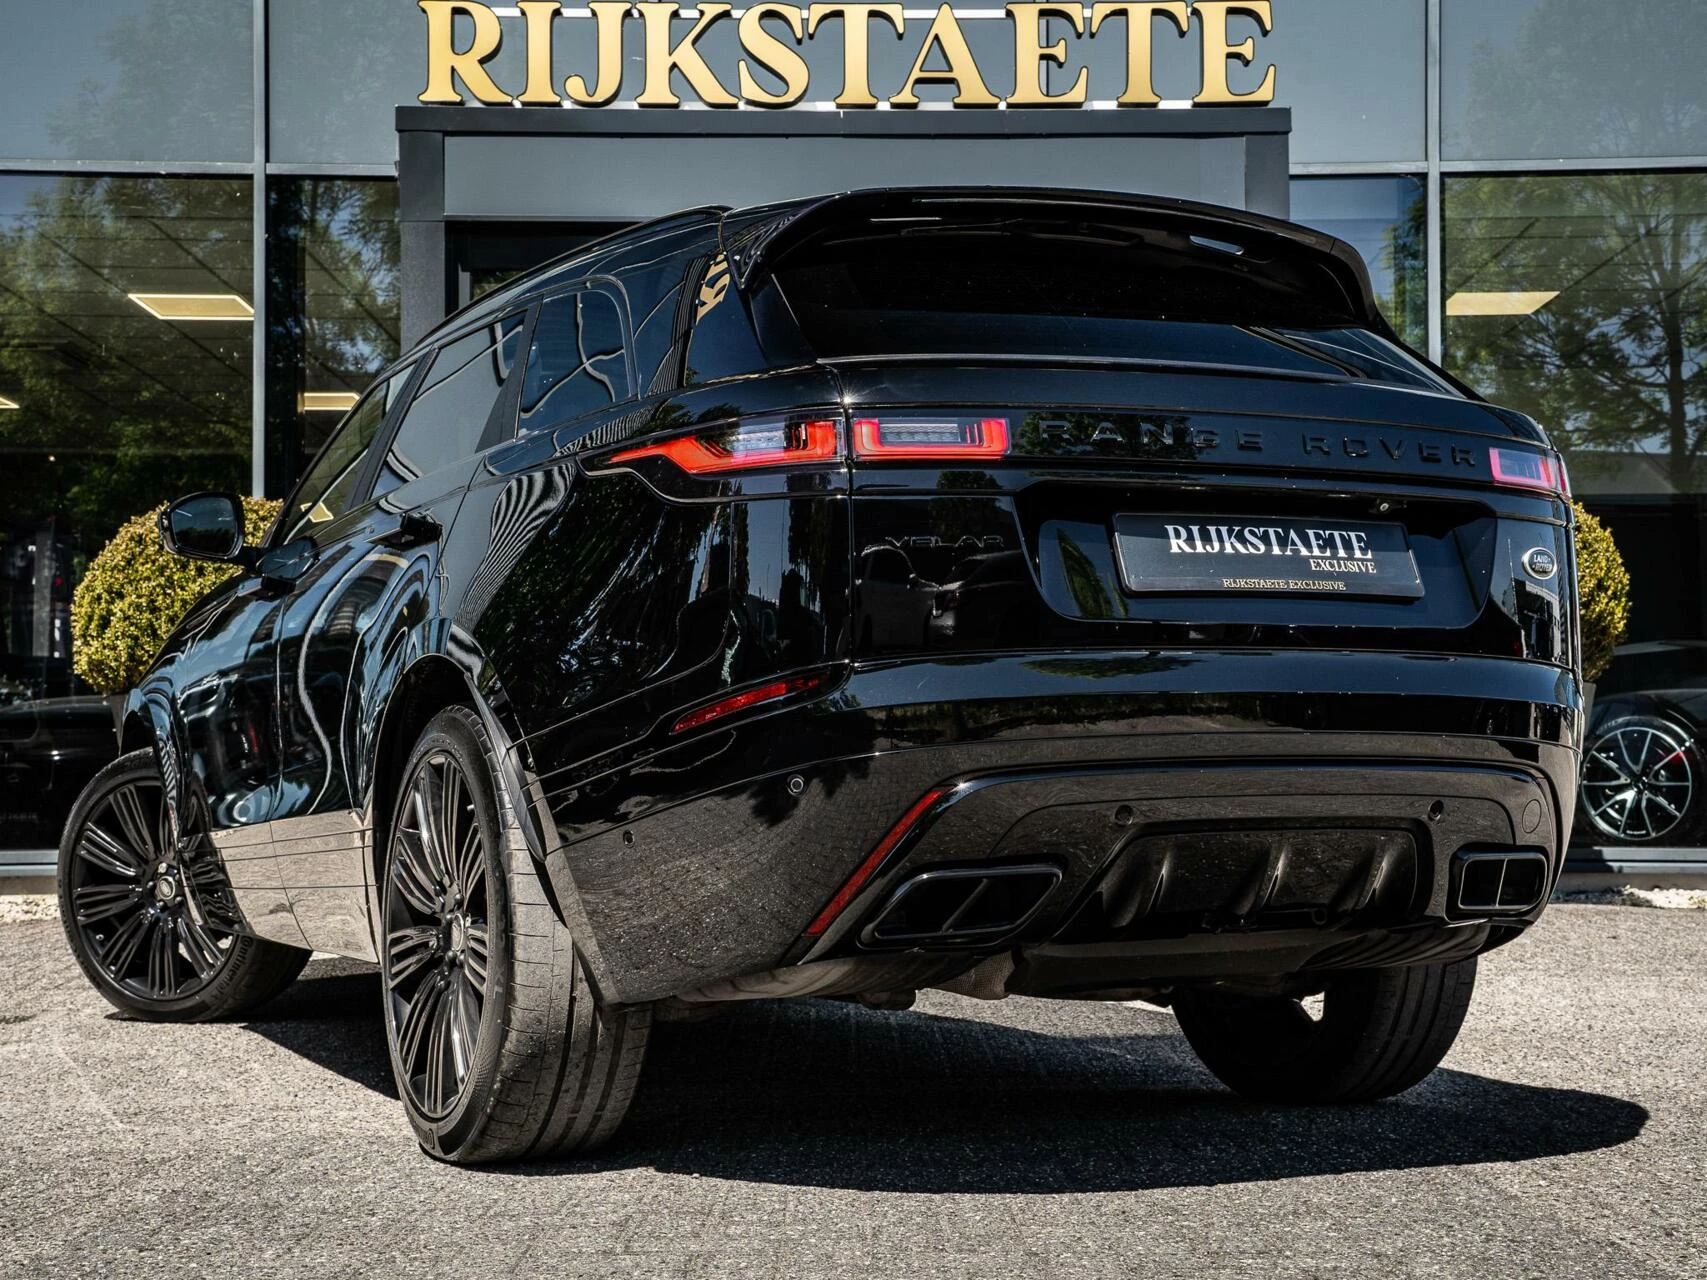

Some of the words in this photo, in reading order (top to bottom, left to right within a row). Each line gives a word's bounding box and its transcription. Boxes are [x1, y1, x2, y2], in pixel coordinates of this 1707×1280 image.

[417, 0, 1277, 109] RIJKSTAETE
[1038, 419, 1263, 452] RANGE
[1301, 431, 1477, 467] ROVER
[884, 535, 1005, 548] VELAR
[1164, 524, 1373, 559] RIJKSTAETE
[1310, 559, 1377, 574] EXCLUSIVE
[1223, 578, 1288, 590] RIJKSTAETE
[1289, 579, 1347, 591] EXCLUSIVE
